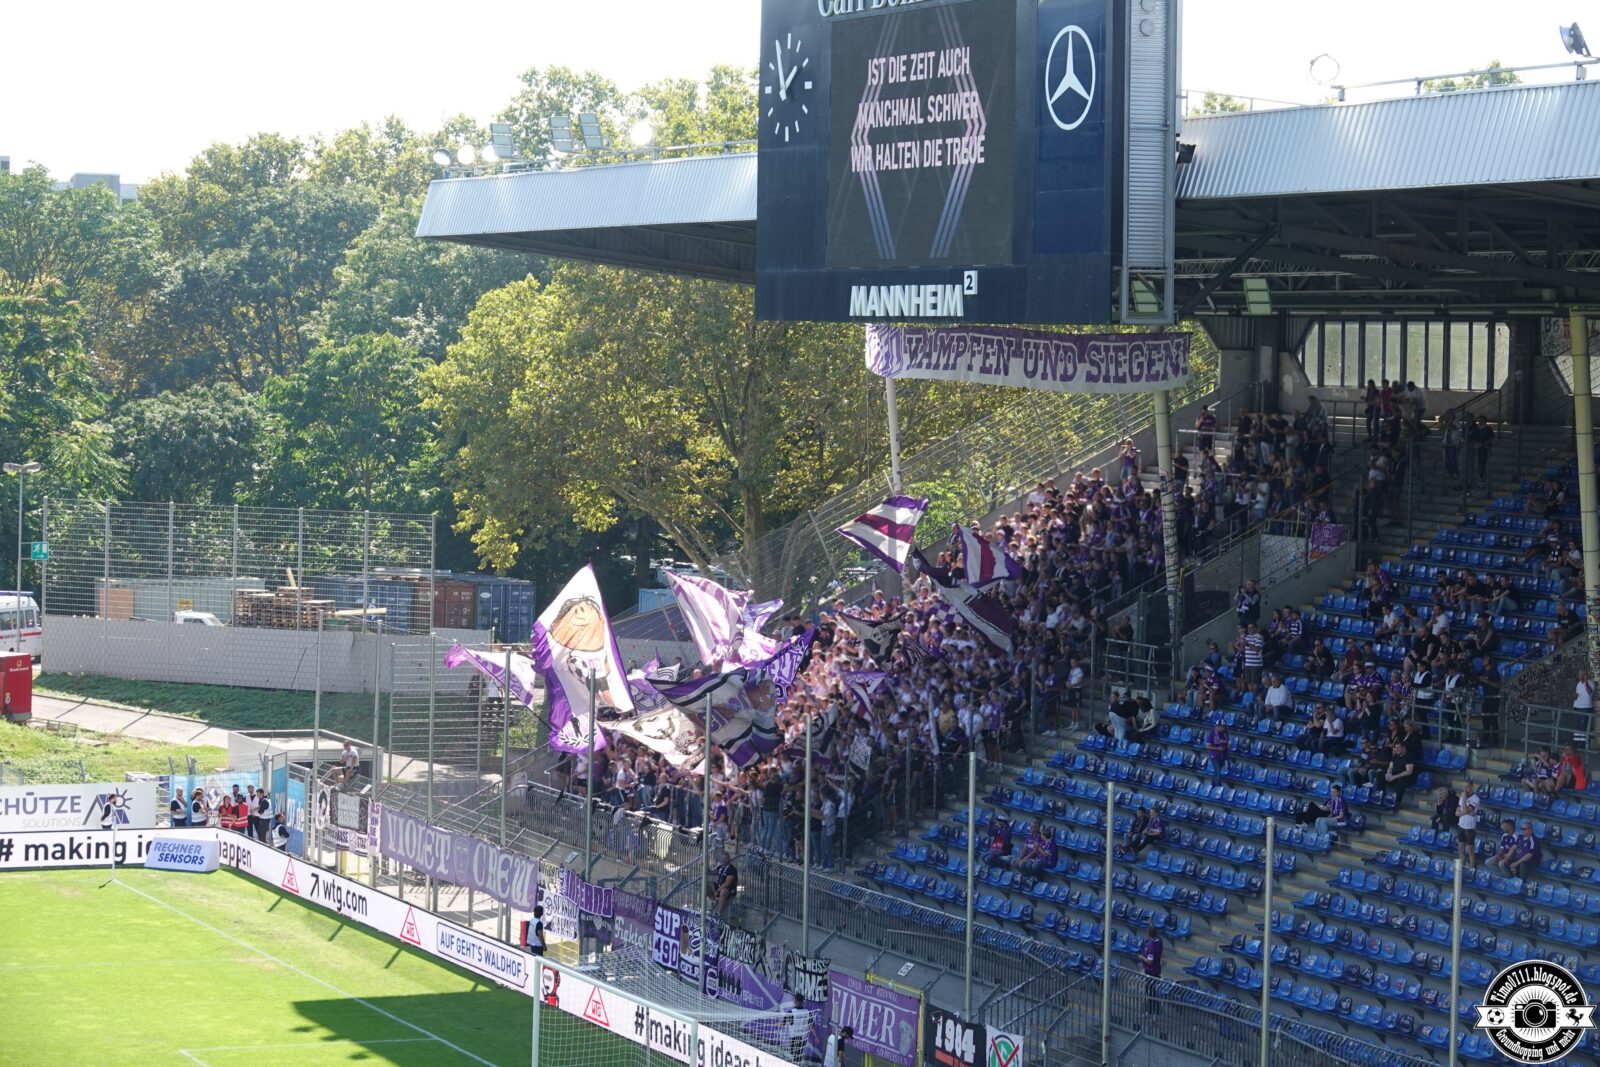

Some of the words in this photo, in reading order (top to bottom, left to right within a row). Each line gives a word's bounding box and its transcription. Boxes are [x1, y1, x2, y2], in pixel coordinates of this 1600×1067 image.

[867, 57, 886, 86] IST
[888, 54, 907, 84] DIE
[909, 51, 936, 82] ZEIT
[937, 46, 970, 79] AUCH
[858, 96, 924, 130] MANCHMAL
[926, 90, 980, 124] SCHWER
[850, 144, 873, 173] WIR
[875, 140, 920, 171] HALTEN
[923, 138, 943, 168] DIE
[945, 134, 986, 166] TREUE
[849, 283, 964, 317] MANNHEIM
[1022, 337, 1078, 383] UND
[1084, 335, 1190, 385] SIEGEN!
[22, 817, 82, 829] SOLUTIONS
[24, 837, 127, 866] making
[153, 842, 203, 855] RECHNER
[157, 852, 206, 866] SENSORS
[386, 812, 451, 876] VIOLET
[322, 878, 368, 917] wtg.com
[654, 905, 681, 938] SUP
[440, 931, 455, 952] AUF
[456, 938, 483, 963] GEHT'S
[484, 948, 522, 979] WALDHOF
[935, 1015, 976, 1064] 1984
